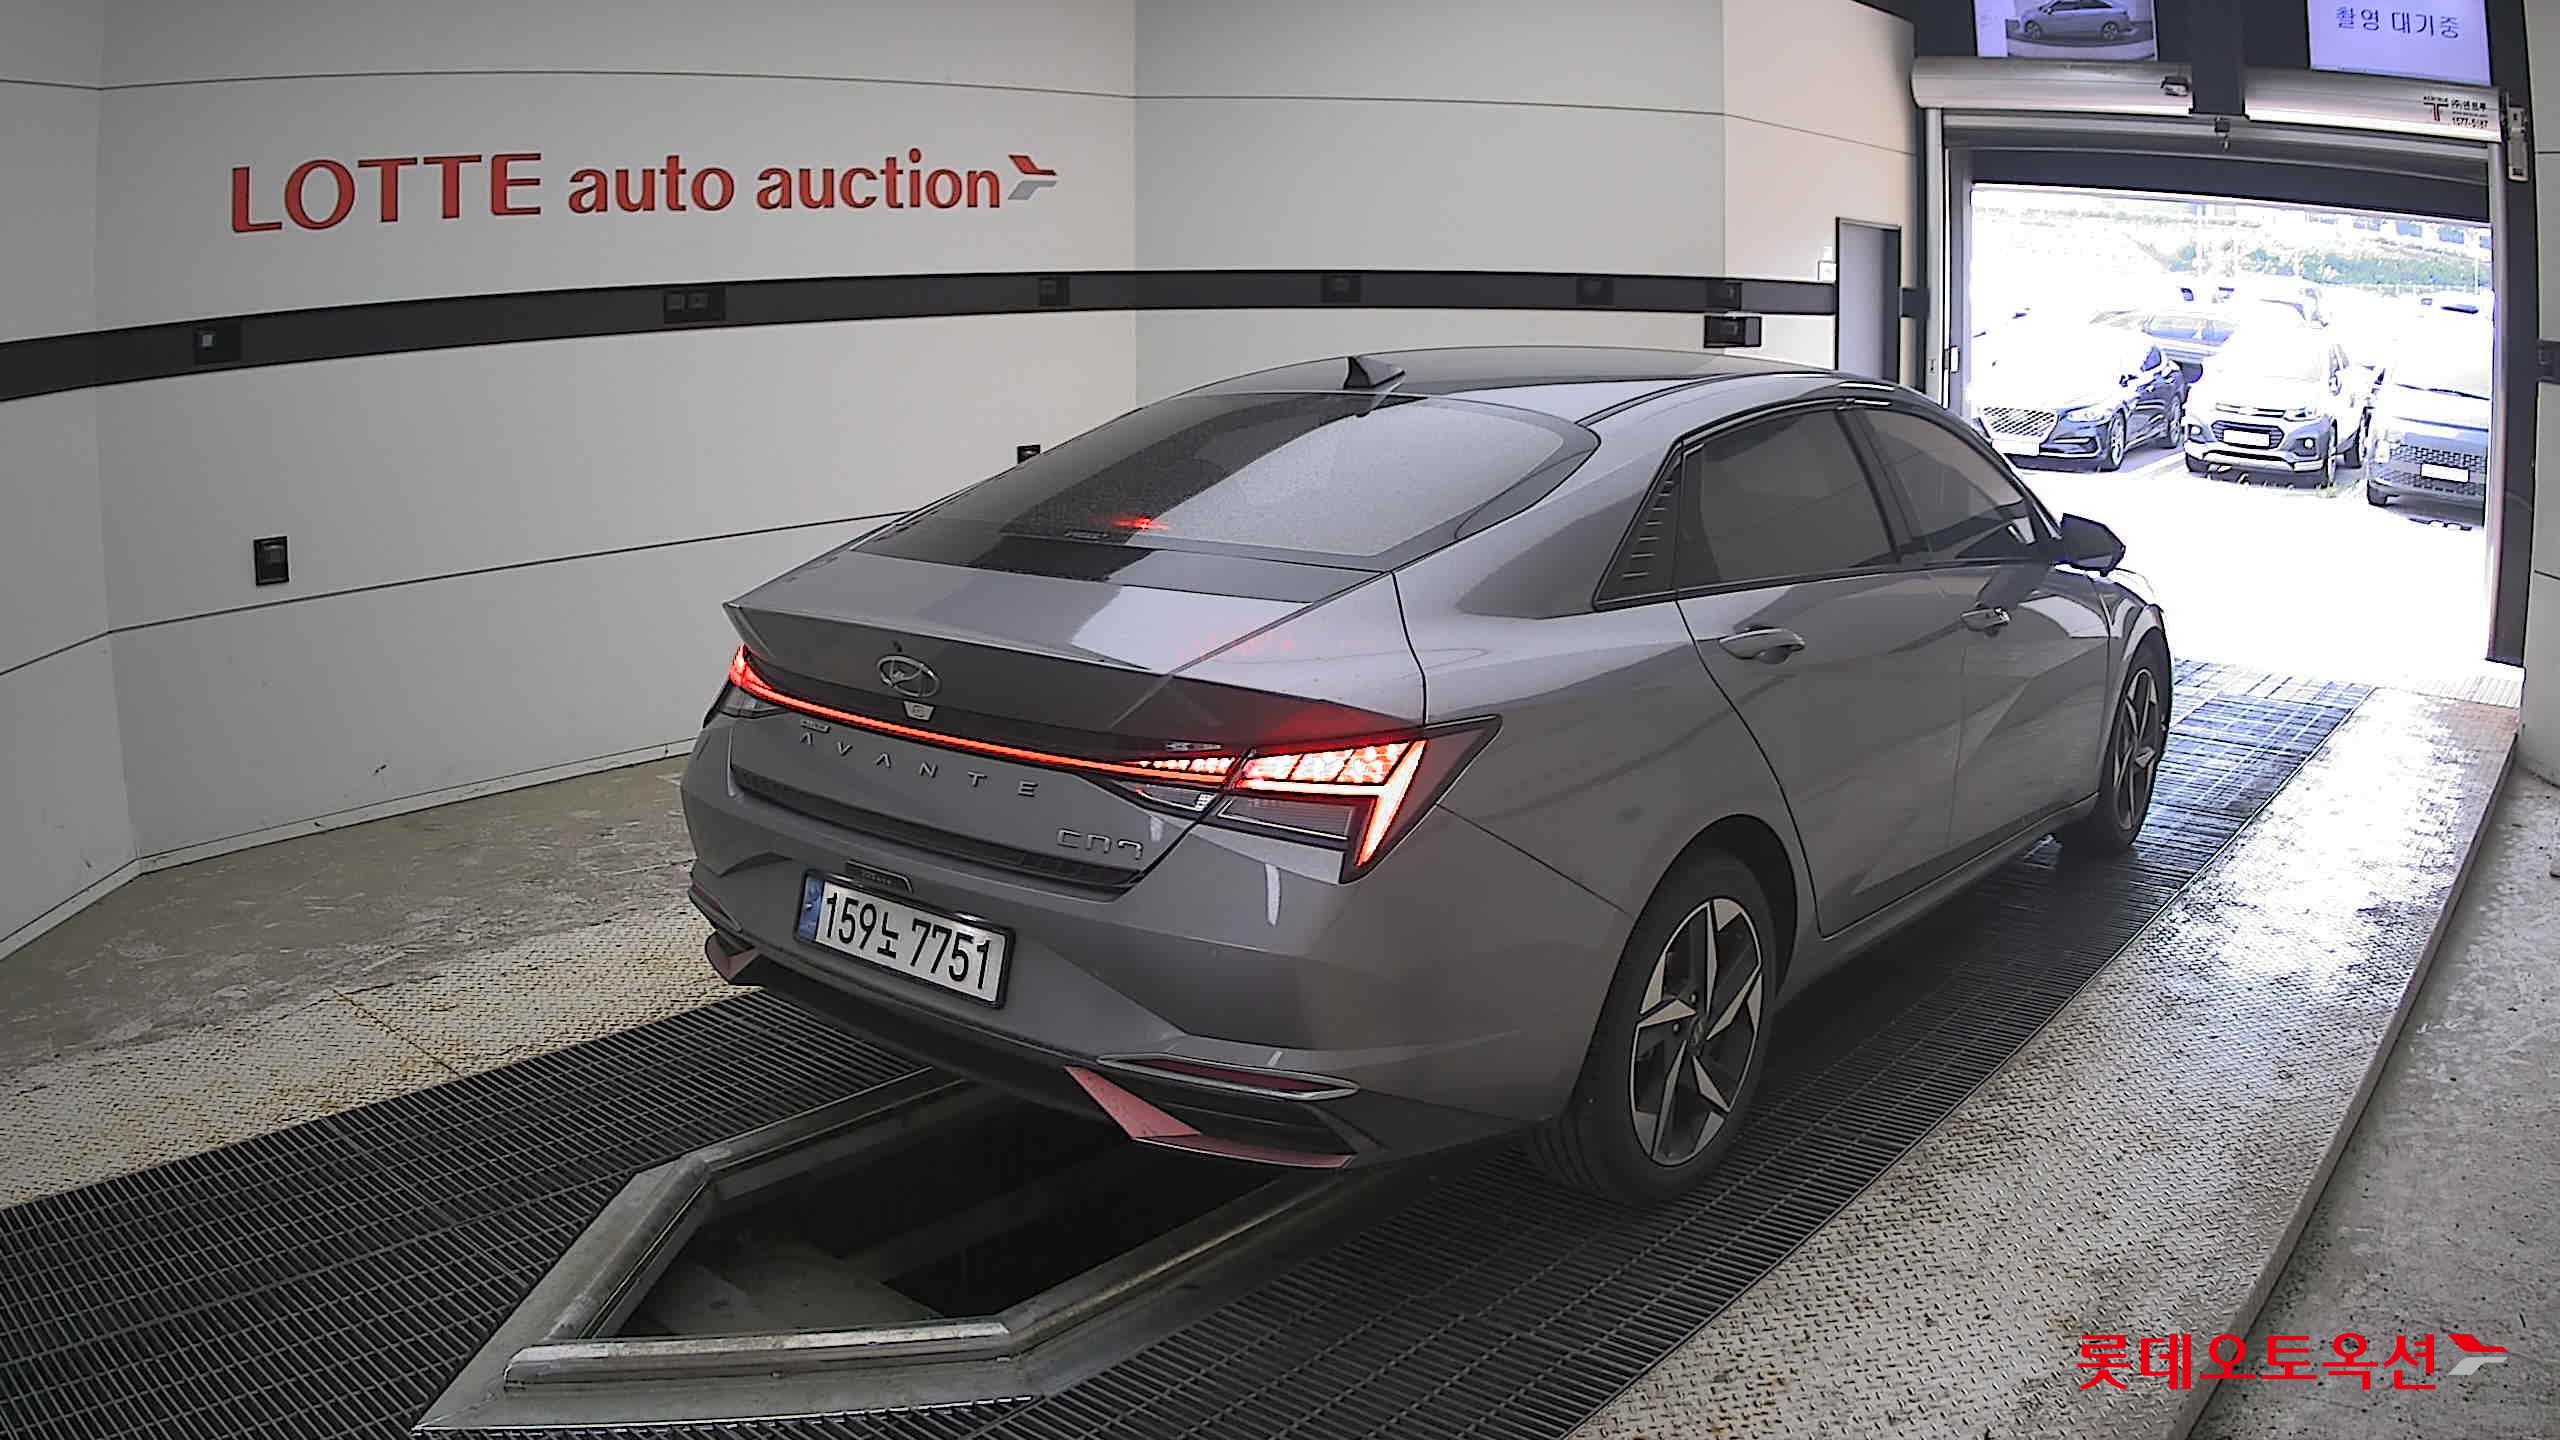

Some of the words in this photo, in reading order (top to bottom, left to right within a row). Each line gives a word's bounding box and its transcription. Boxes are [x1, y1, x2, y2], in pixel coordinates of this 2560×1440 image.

[2336, 6, 2380, 31] 촬영
[2391, 12, 2460, 39] 대기중
[232, 152, 541, 232] LOTTE
[568, 155, 735, 213] auto
[756, 148, 1001, 210] auction
[799, 732, 1039, 798] AVANTE
[1056, 827, 1144, 861] CN7
[826, 892, 899, 959] 159노
[910, 917, 992, 990] 7751
